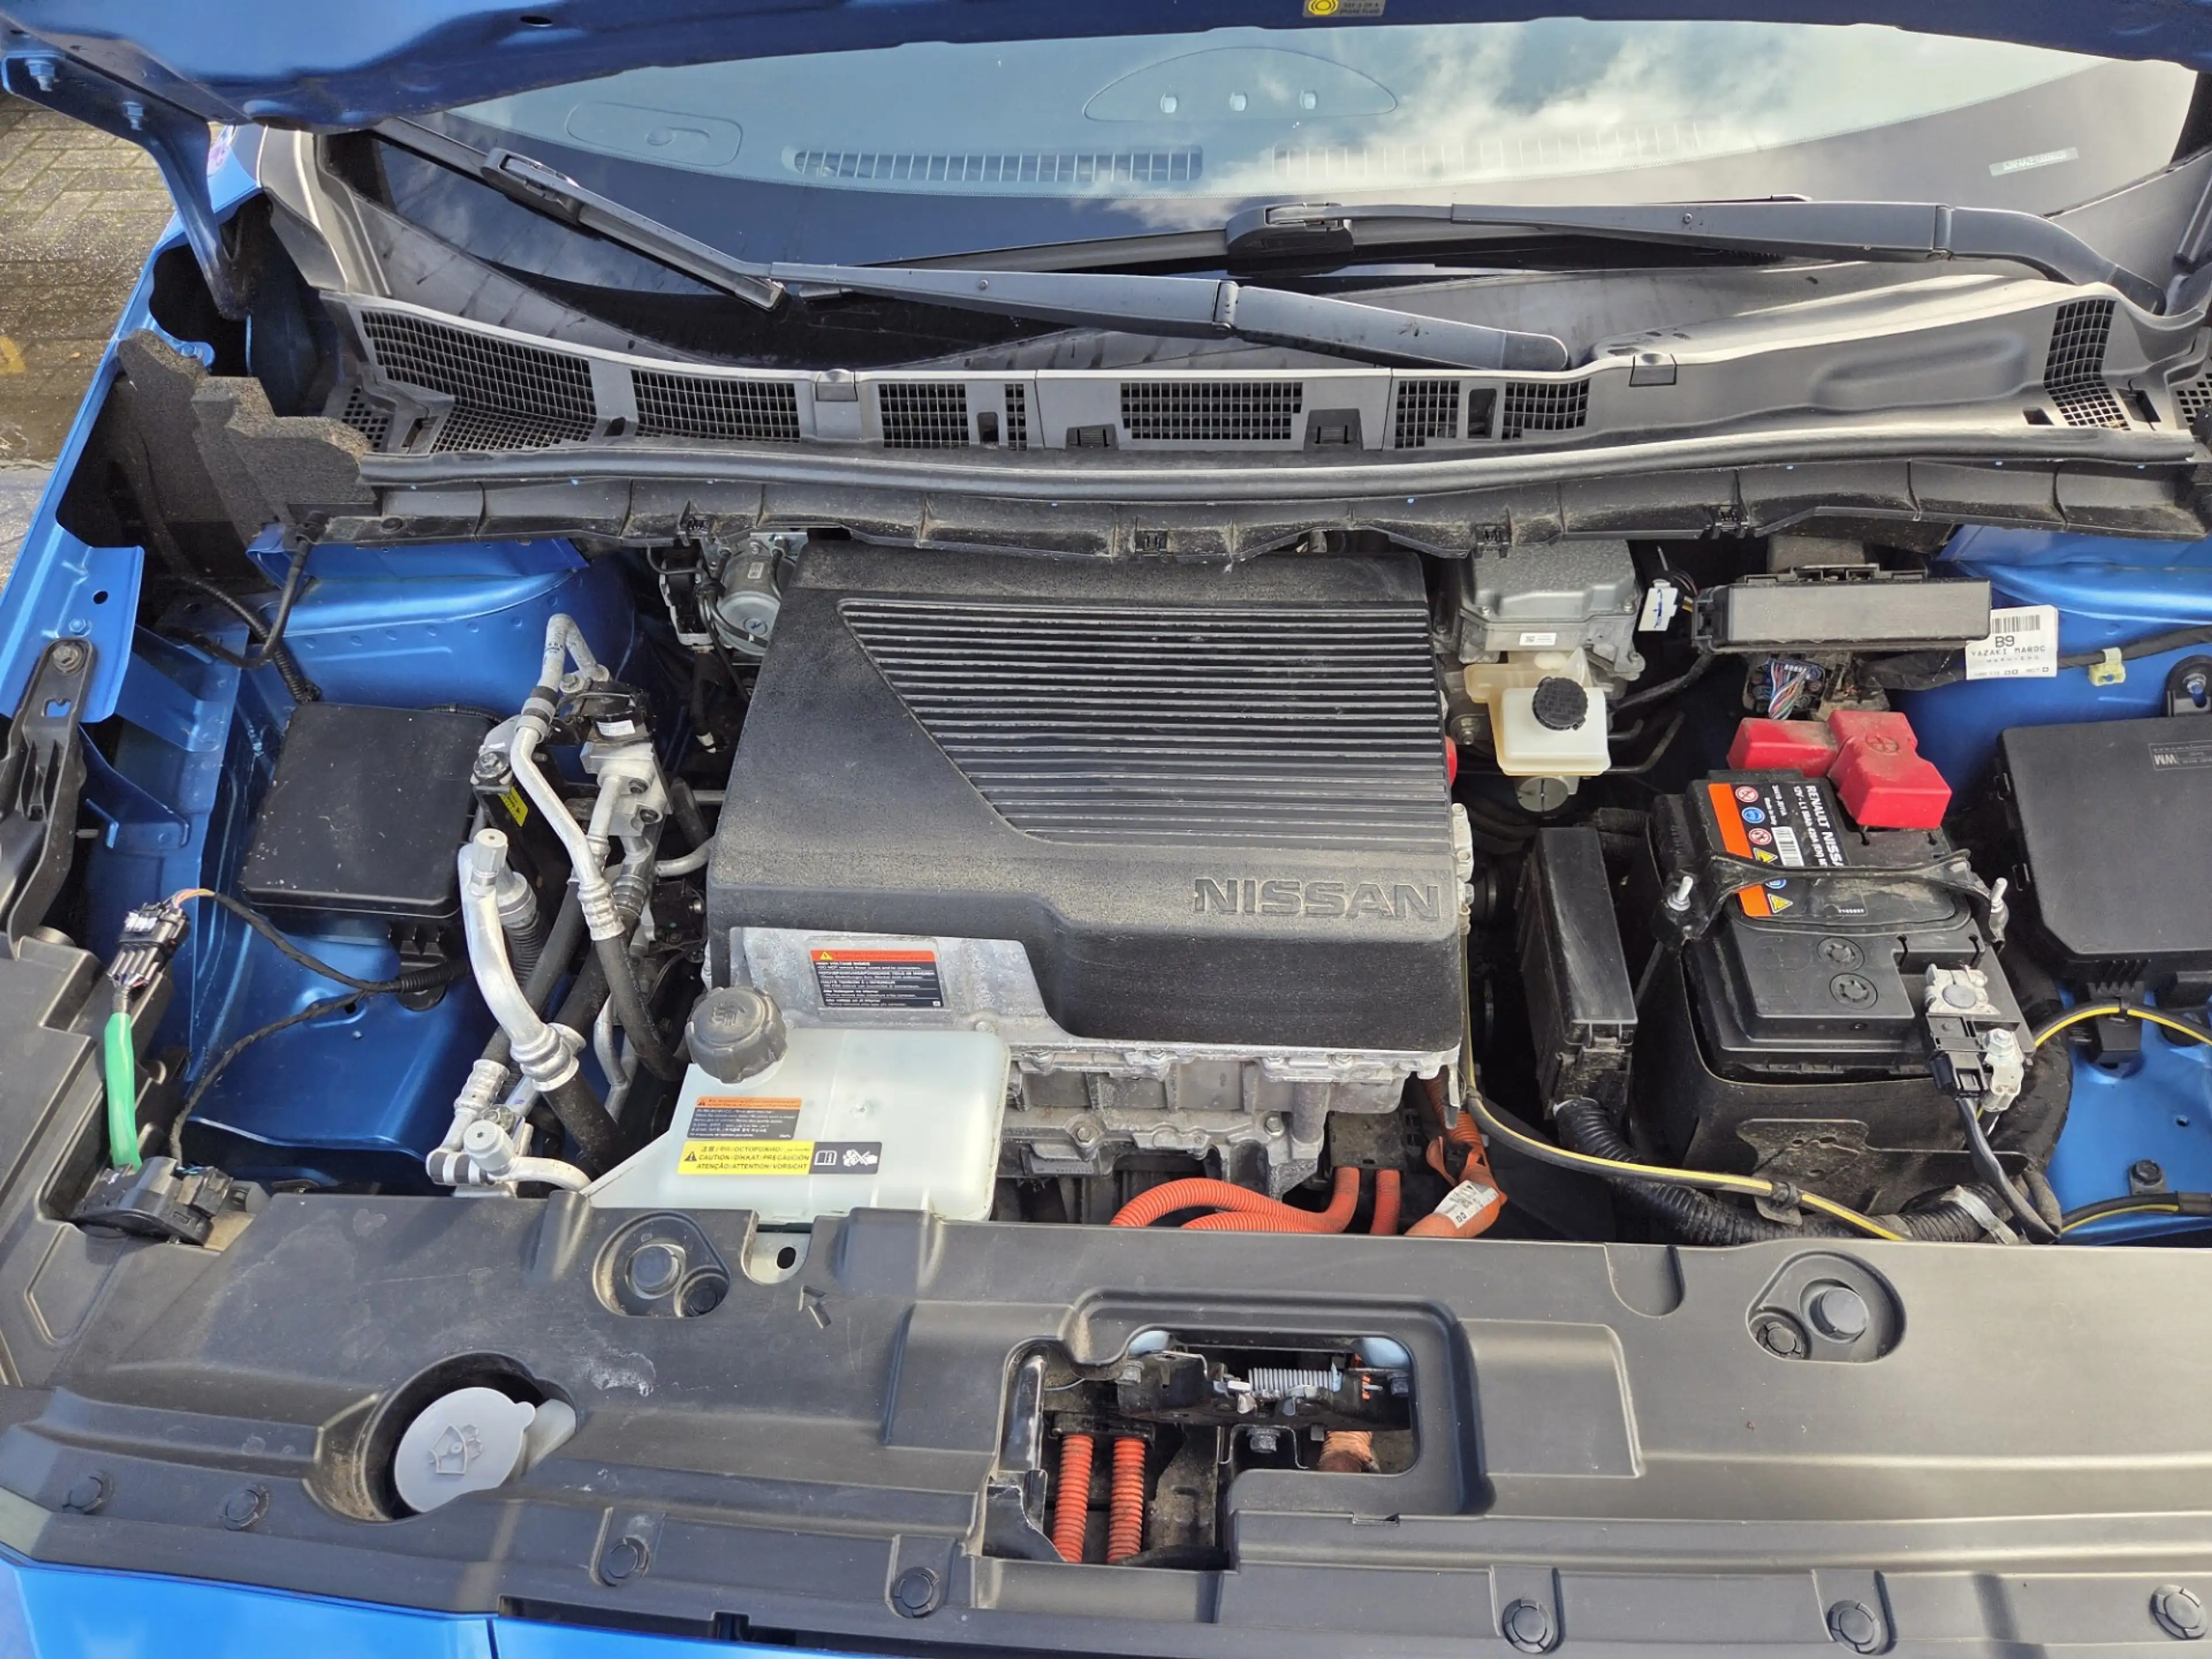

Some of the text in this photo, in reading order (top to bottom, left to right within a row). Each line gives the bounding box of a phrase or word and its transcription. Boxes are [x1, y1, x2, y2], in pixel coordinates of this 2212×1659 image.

[1971, 645, 2046, 657] YAZAKI MAROC
[1995, 635, 2015, 648] B9
[1805, 785, 1831, 829] RENAULT
[1194, 877, 1442, 922] NISSAN
